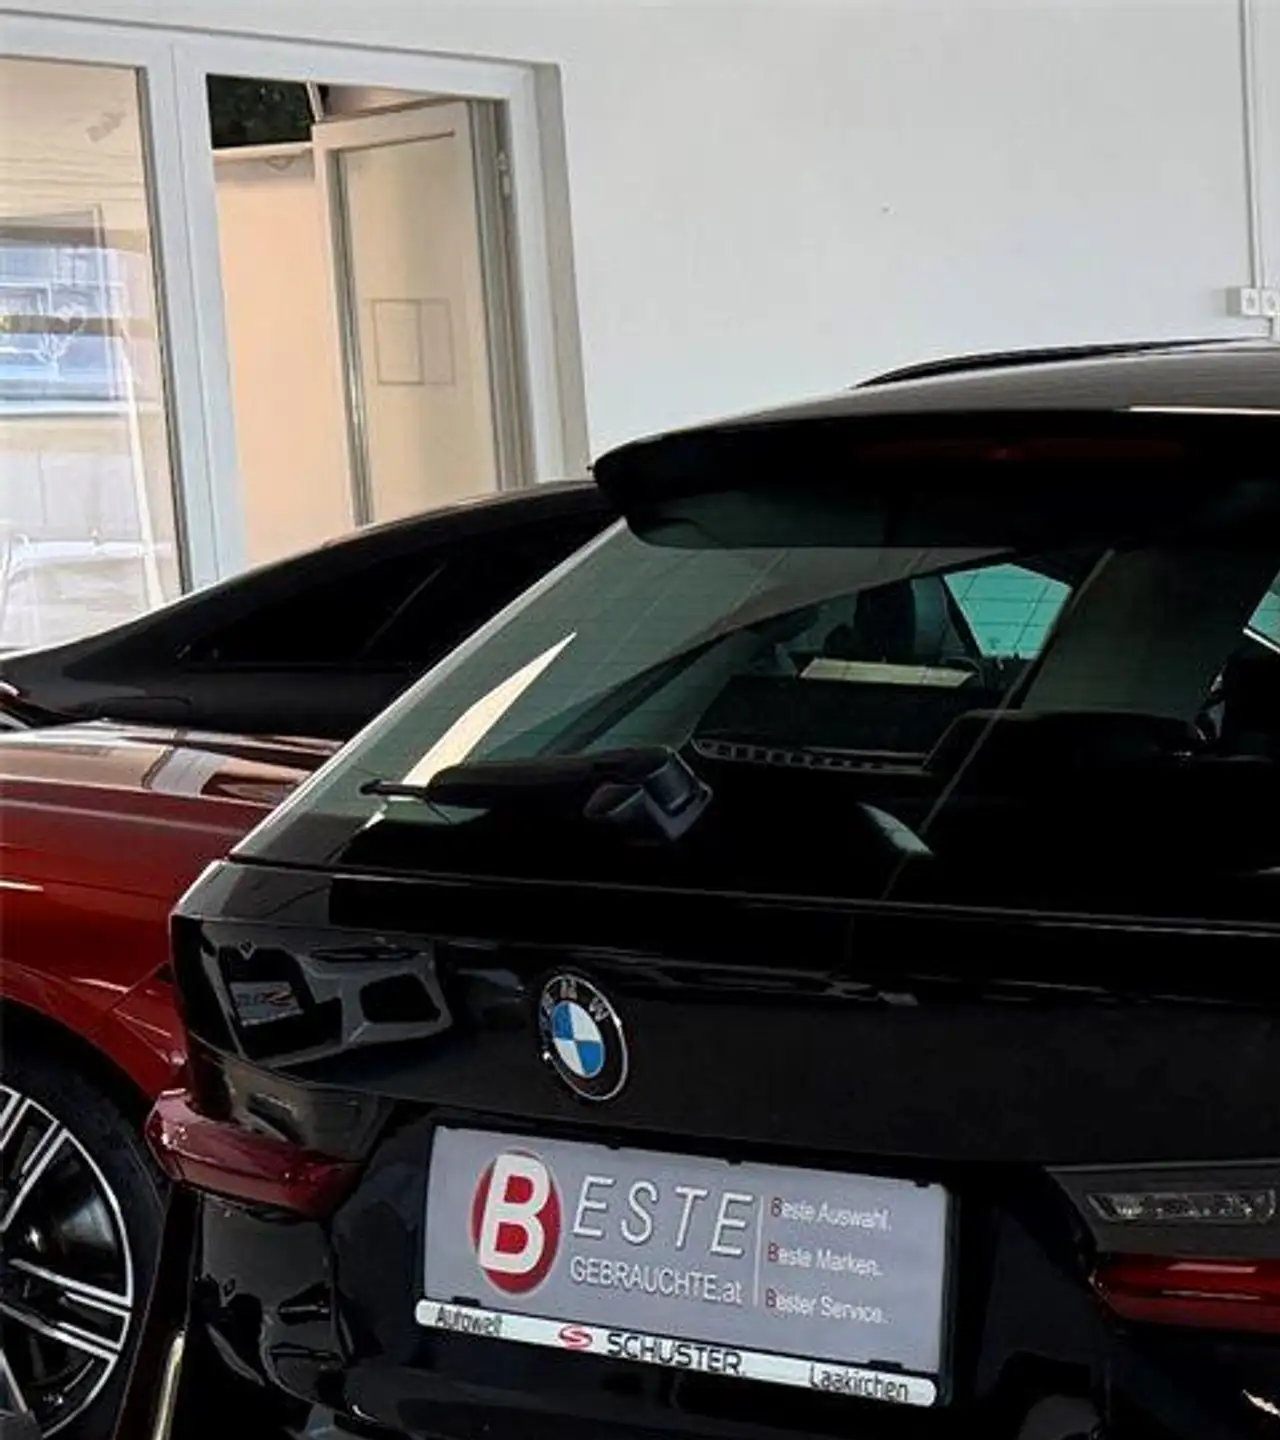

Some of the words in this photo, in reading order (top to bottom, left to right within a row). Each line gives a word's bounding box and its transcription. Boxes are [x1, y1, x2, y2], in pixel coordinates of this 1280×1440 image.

[477, 1151, 755, 1274] BESTE
[769, 1196, 811, 1221] Beste
[815, 1201, 892, 1232] Auswahl.
[767, 1242, 812, 1268] Beste
[569, 1254, 744, 1305] GEBRAUCHTE.at
[765, 1287, 817, 1315] Bester
[606, 1332, 744, 1376] SCHUSTER
[807, 1363, 910, 1403] Laakirchen
